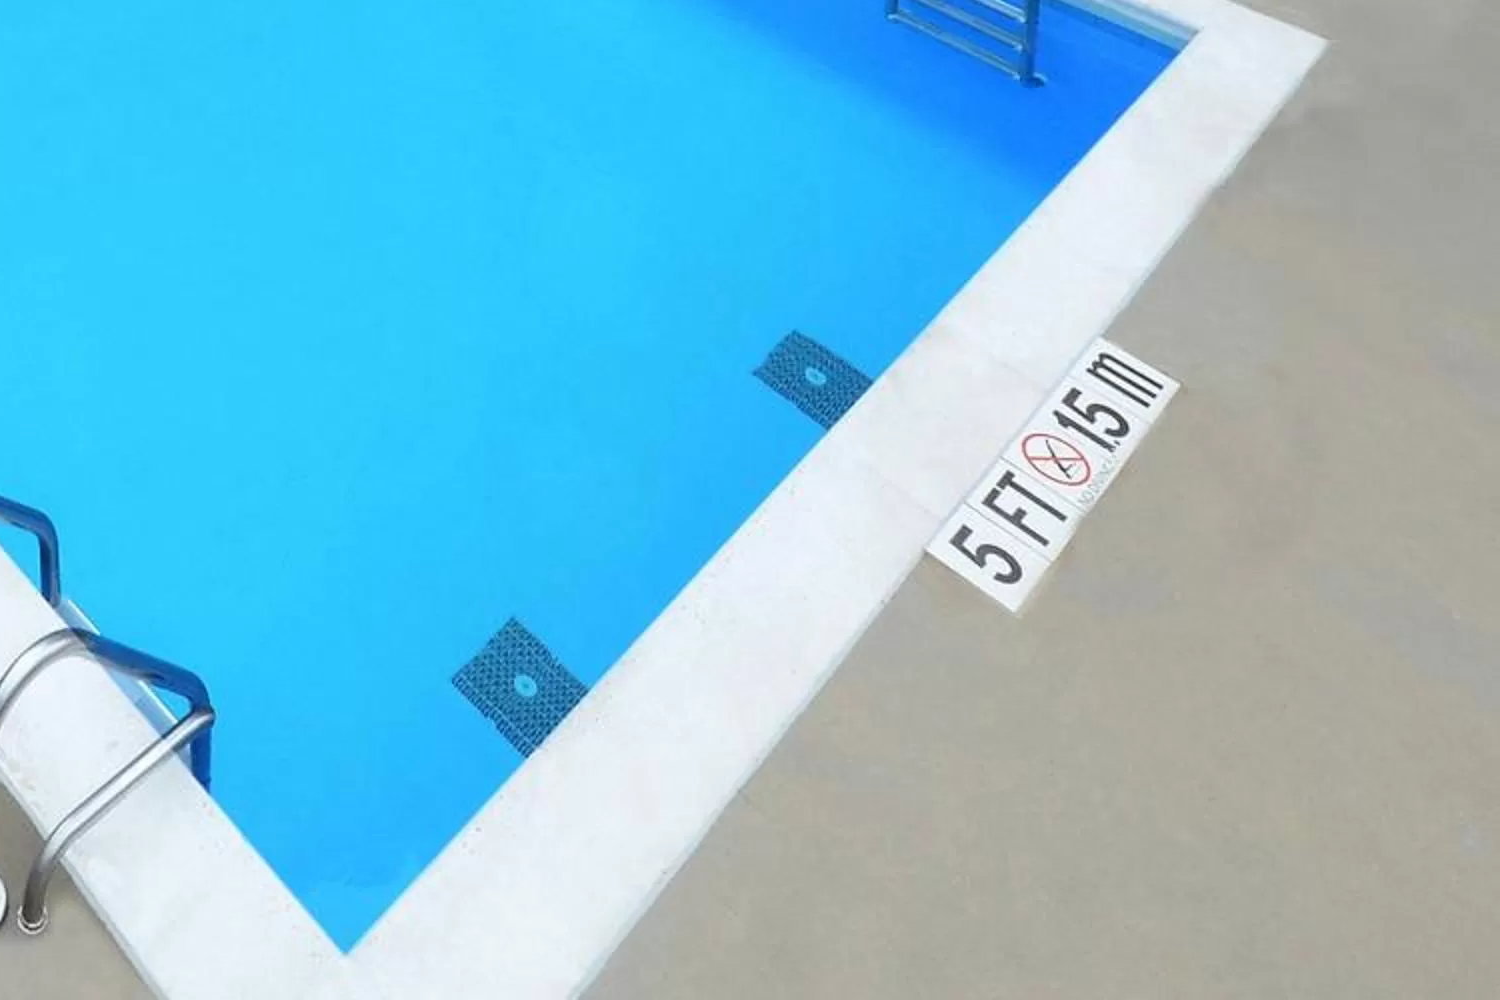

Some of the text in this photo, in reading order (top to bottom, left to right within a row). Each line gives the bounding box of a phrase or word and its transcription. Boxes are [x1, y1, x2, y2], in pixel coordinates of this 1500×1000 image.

[1086, 352, 1164, 408] m
[980, 470, 1067, 547] FT
[948, 524, 1023, 585] 5
